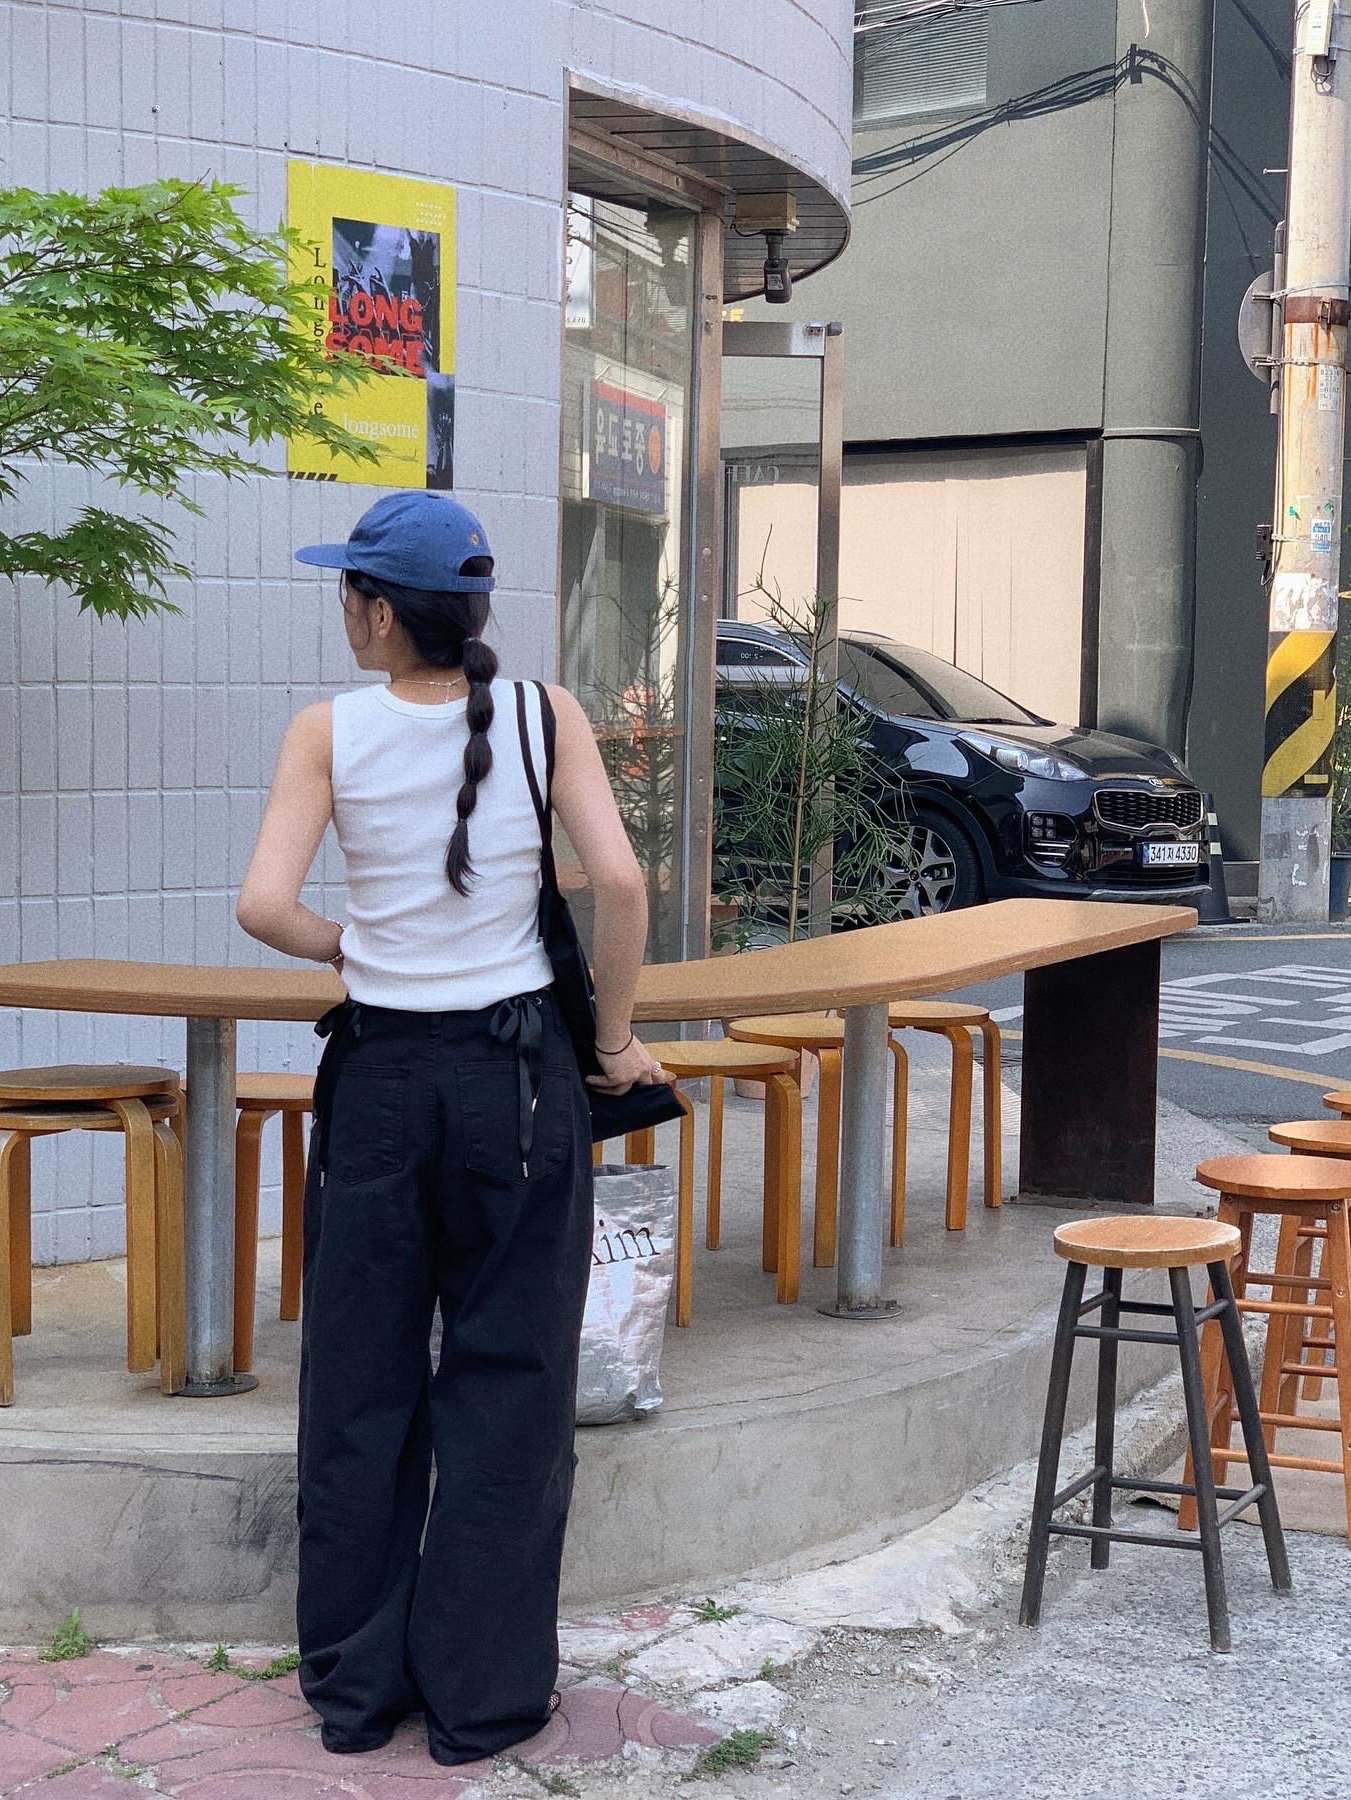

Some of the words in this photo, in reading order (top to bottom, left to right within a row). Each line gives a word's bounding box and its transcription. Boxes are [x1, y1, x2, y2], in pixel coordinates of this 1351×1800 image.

[328, 288, 423, 332] LONG
[324, 330, 426, 378] SOME
[342, 411, 421, 441] longsome
[592, 1219, 661, 1267] im
